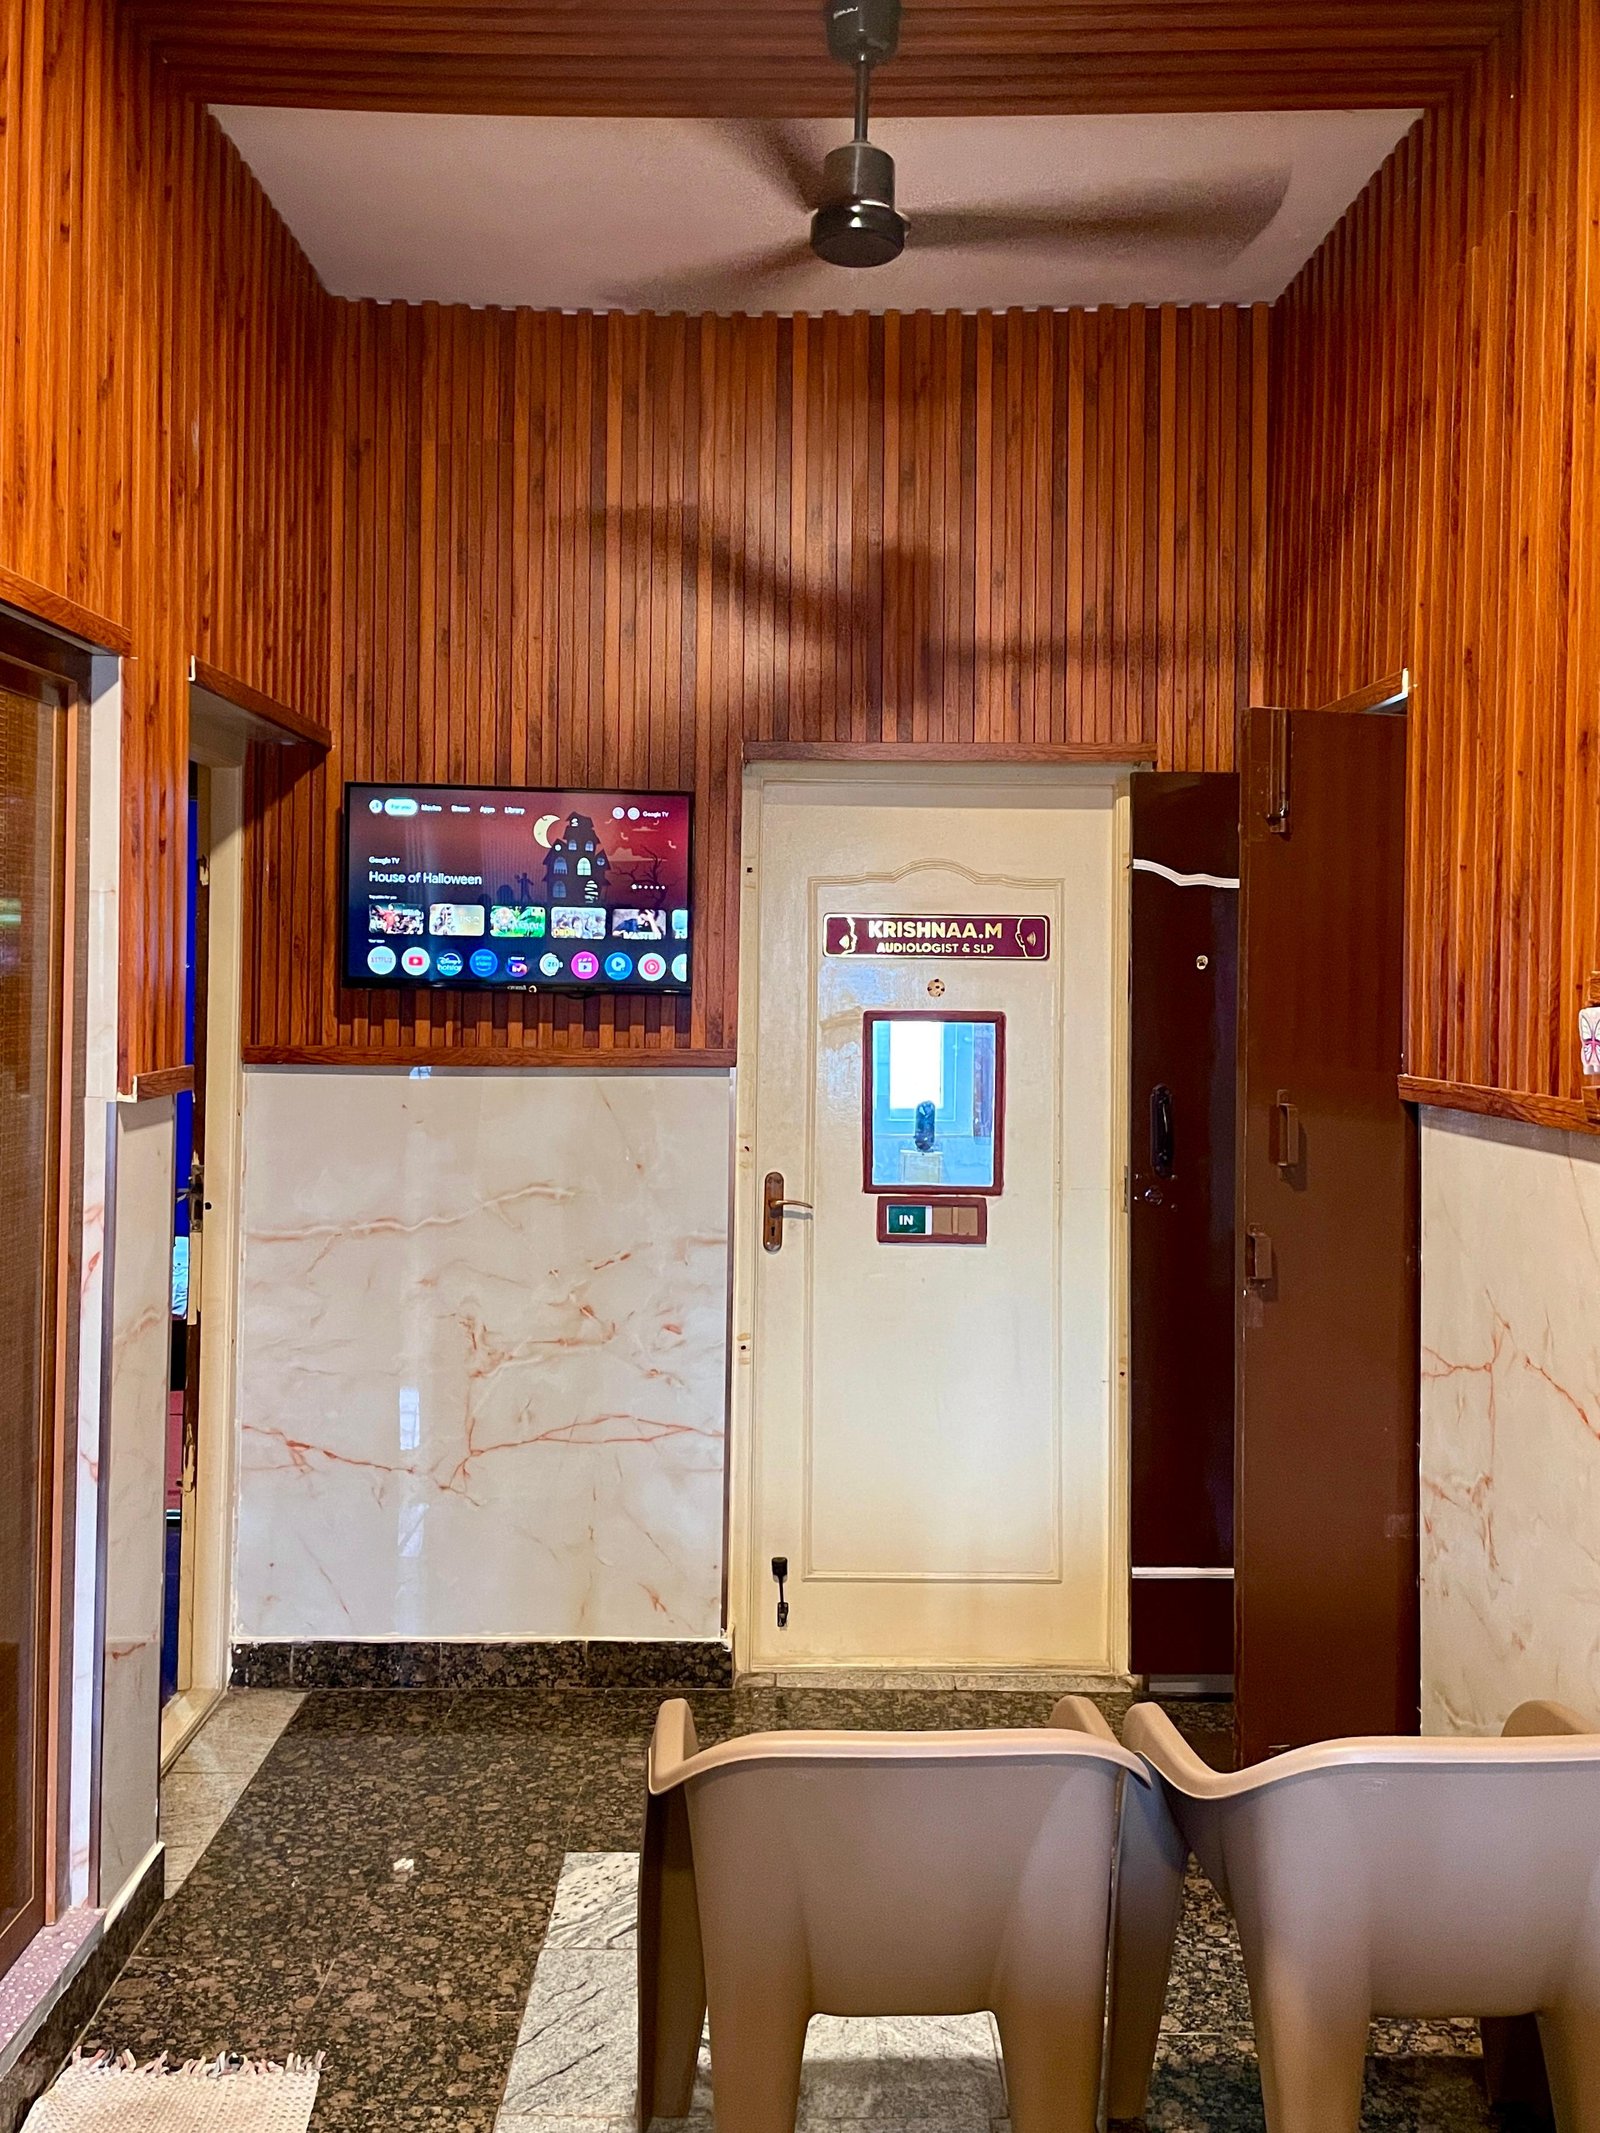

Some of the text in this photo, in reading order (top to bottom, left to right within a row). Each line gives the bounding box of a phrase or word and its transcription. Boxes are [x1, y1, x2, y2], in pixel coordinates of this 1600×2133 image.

[368, 856, 391, 865] Google
[368, 871, 482, 885] House of Halloween
[868, 920, 1003, 939] KRISHNAA.M
[876, 942, 994, 953] AUDIOLOGIST & SLP
[899, 1215, 914, 1226] IN
